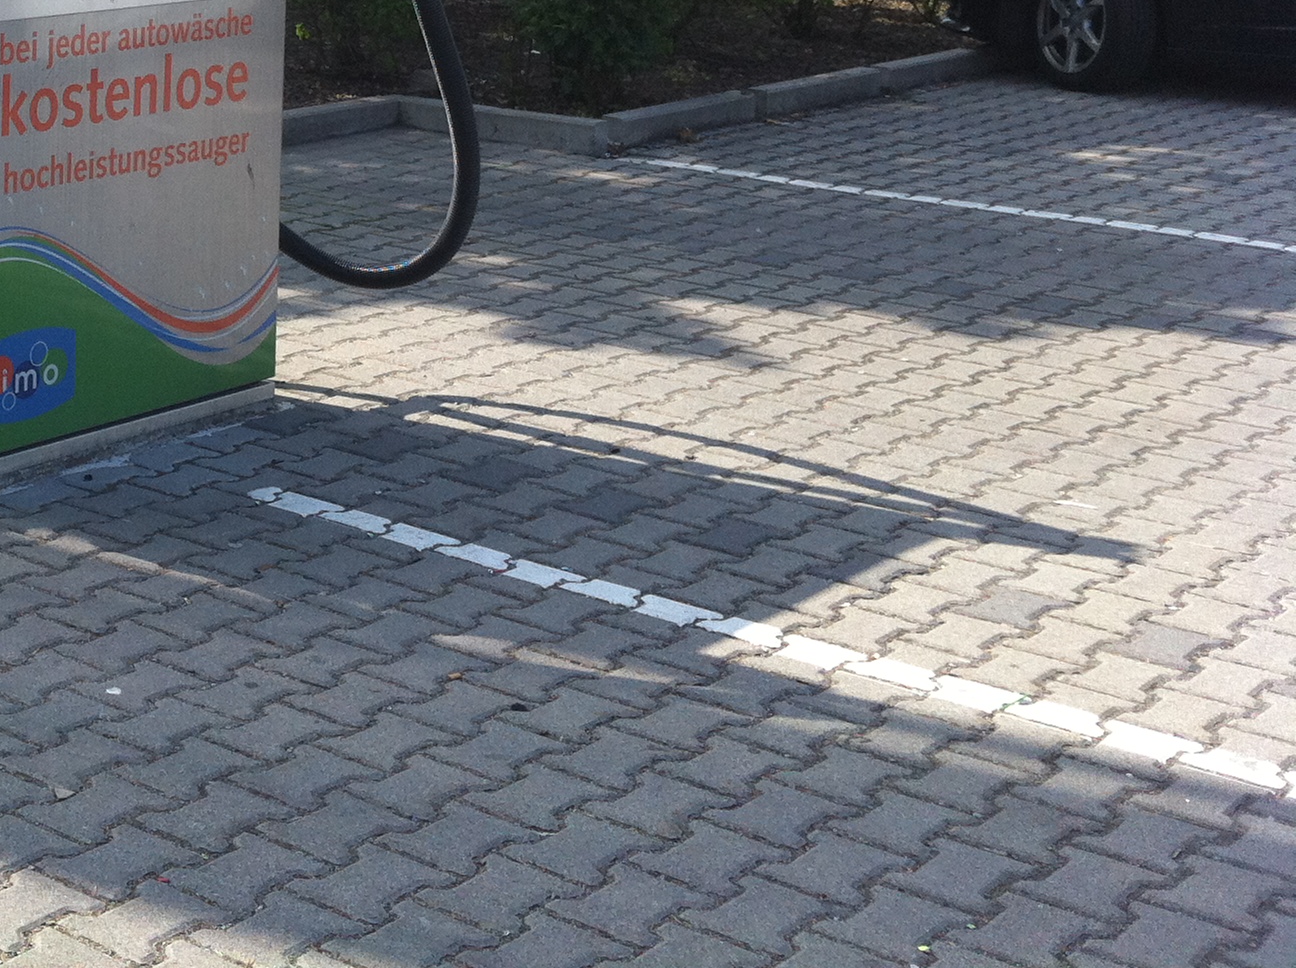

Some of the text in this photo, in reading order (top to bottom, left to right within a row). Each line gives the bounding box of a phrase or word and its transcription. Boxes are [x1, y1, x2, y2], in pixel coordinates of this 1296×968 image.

[0, 7, 253, 69] bei jeder autowäsche
[0, 53, 250, 137] kostenlose
[3, 132, 250, 195] hochleistungssauger
[2, 363, 59, 394] imo
